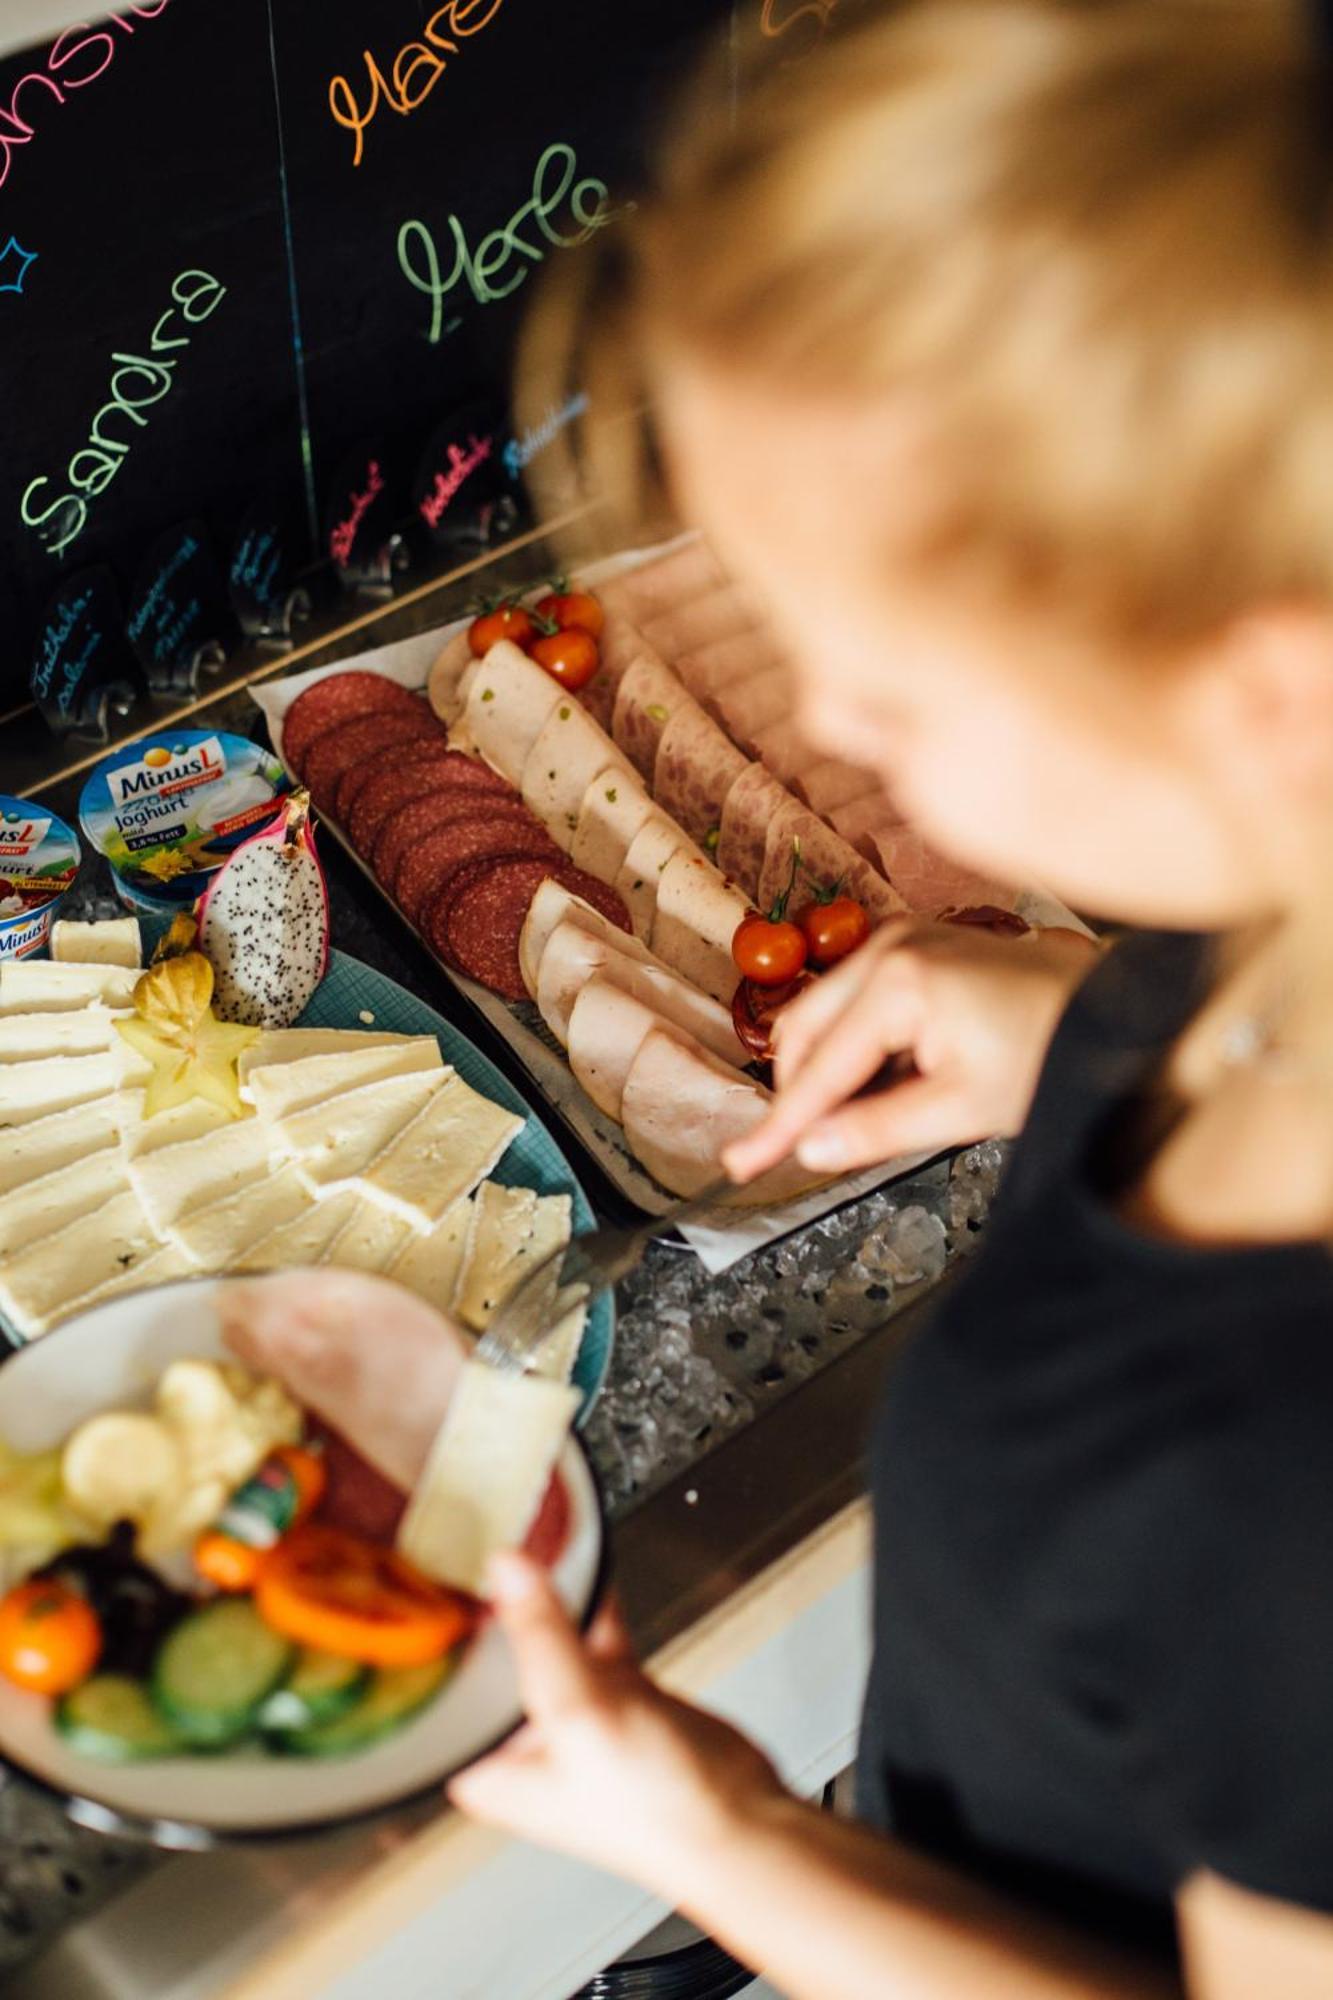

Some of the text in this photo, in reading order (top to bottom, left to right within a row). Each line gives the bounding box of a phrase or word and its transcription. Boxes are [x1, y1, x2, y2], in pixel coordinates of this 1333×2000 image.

[20, 269, 227, 555] Sandra
[121, 747, 220, 799] MinusL
[114, 797, 189, 832] Joghurt
